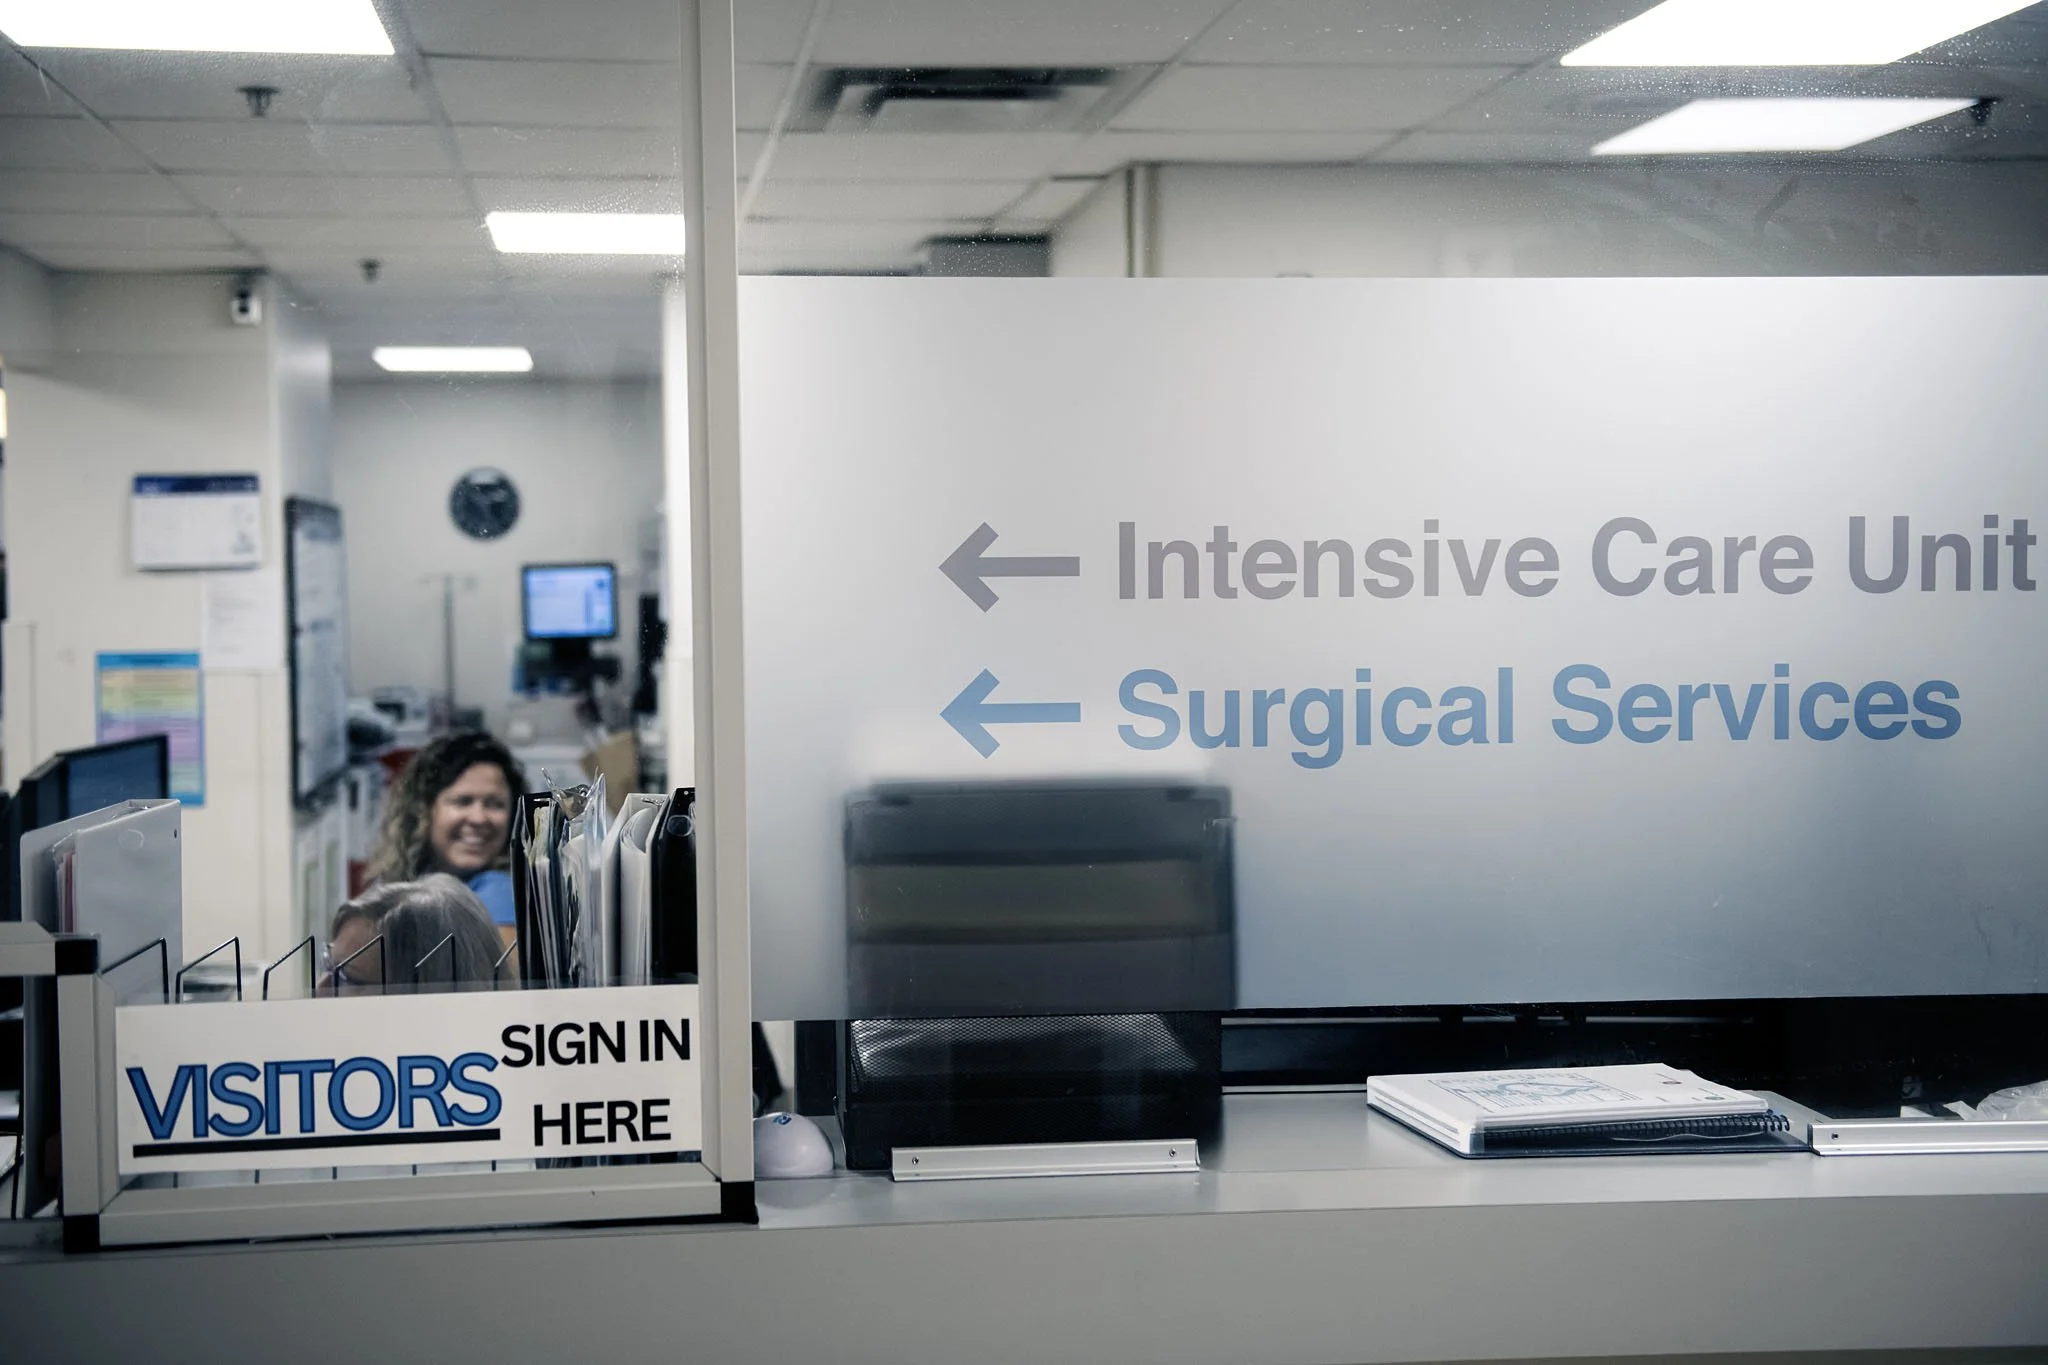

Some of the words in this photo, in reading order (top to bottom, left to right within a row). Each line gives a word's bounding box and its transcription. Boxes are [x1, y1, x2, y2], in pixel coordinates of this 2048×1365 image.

[1118, 519, 1560, 600] Intensive
[1592, 516, 1814, 596] Care
[1848, 515, 2037, 593] Unit
[1118, 667, 1514, 769] Surgical
[1551, 664, 1962, 745] Services
[502, 1021, 626, 1068] SIGN
[640, 1019, 691, 1062] IN
[127, 1053, 502, 1140] VISITORS
[534, 1099, 670, 1147] HERE
